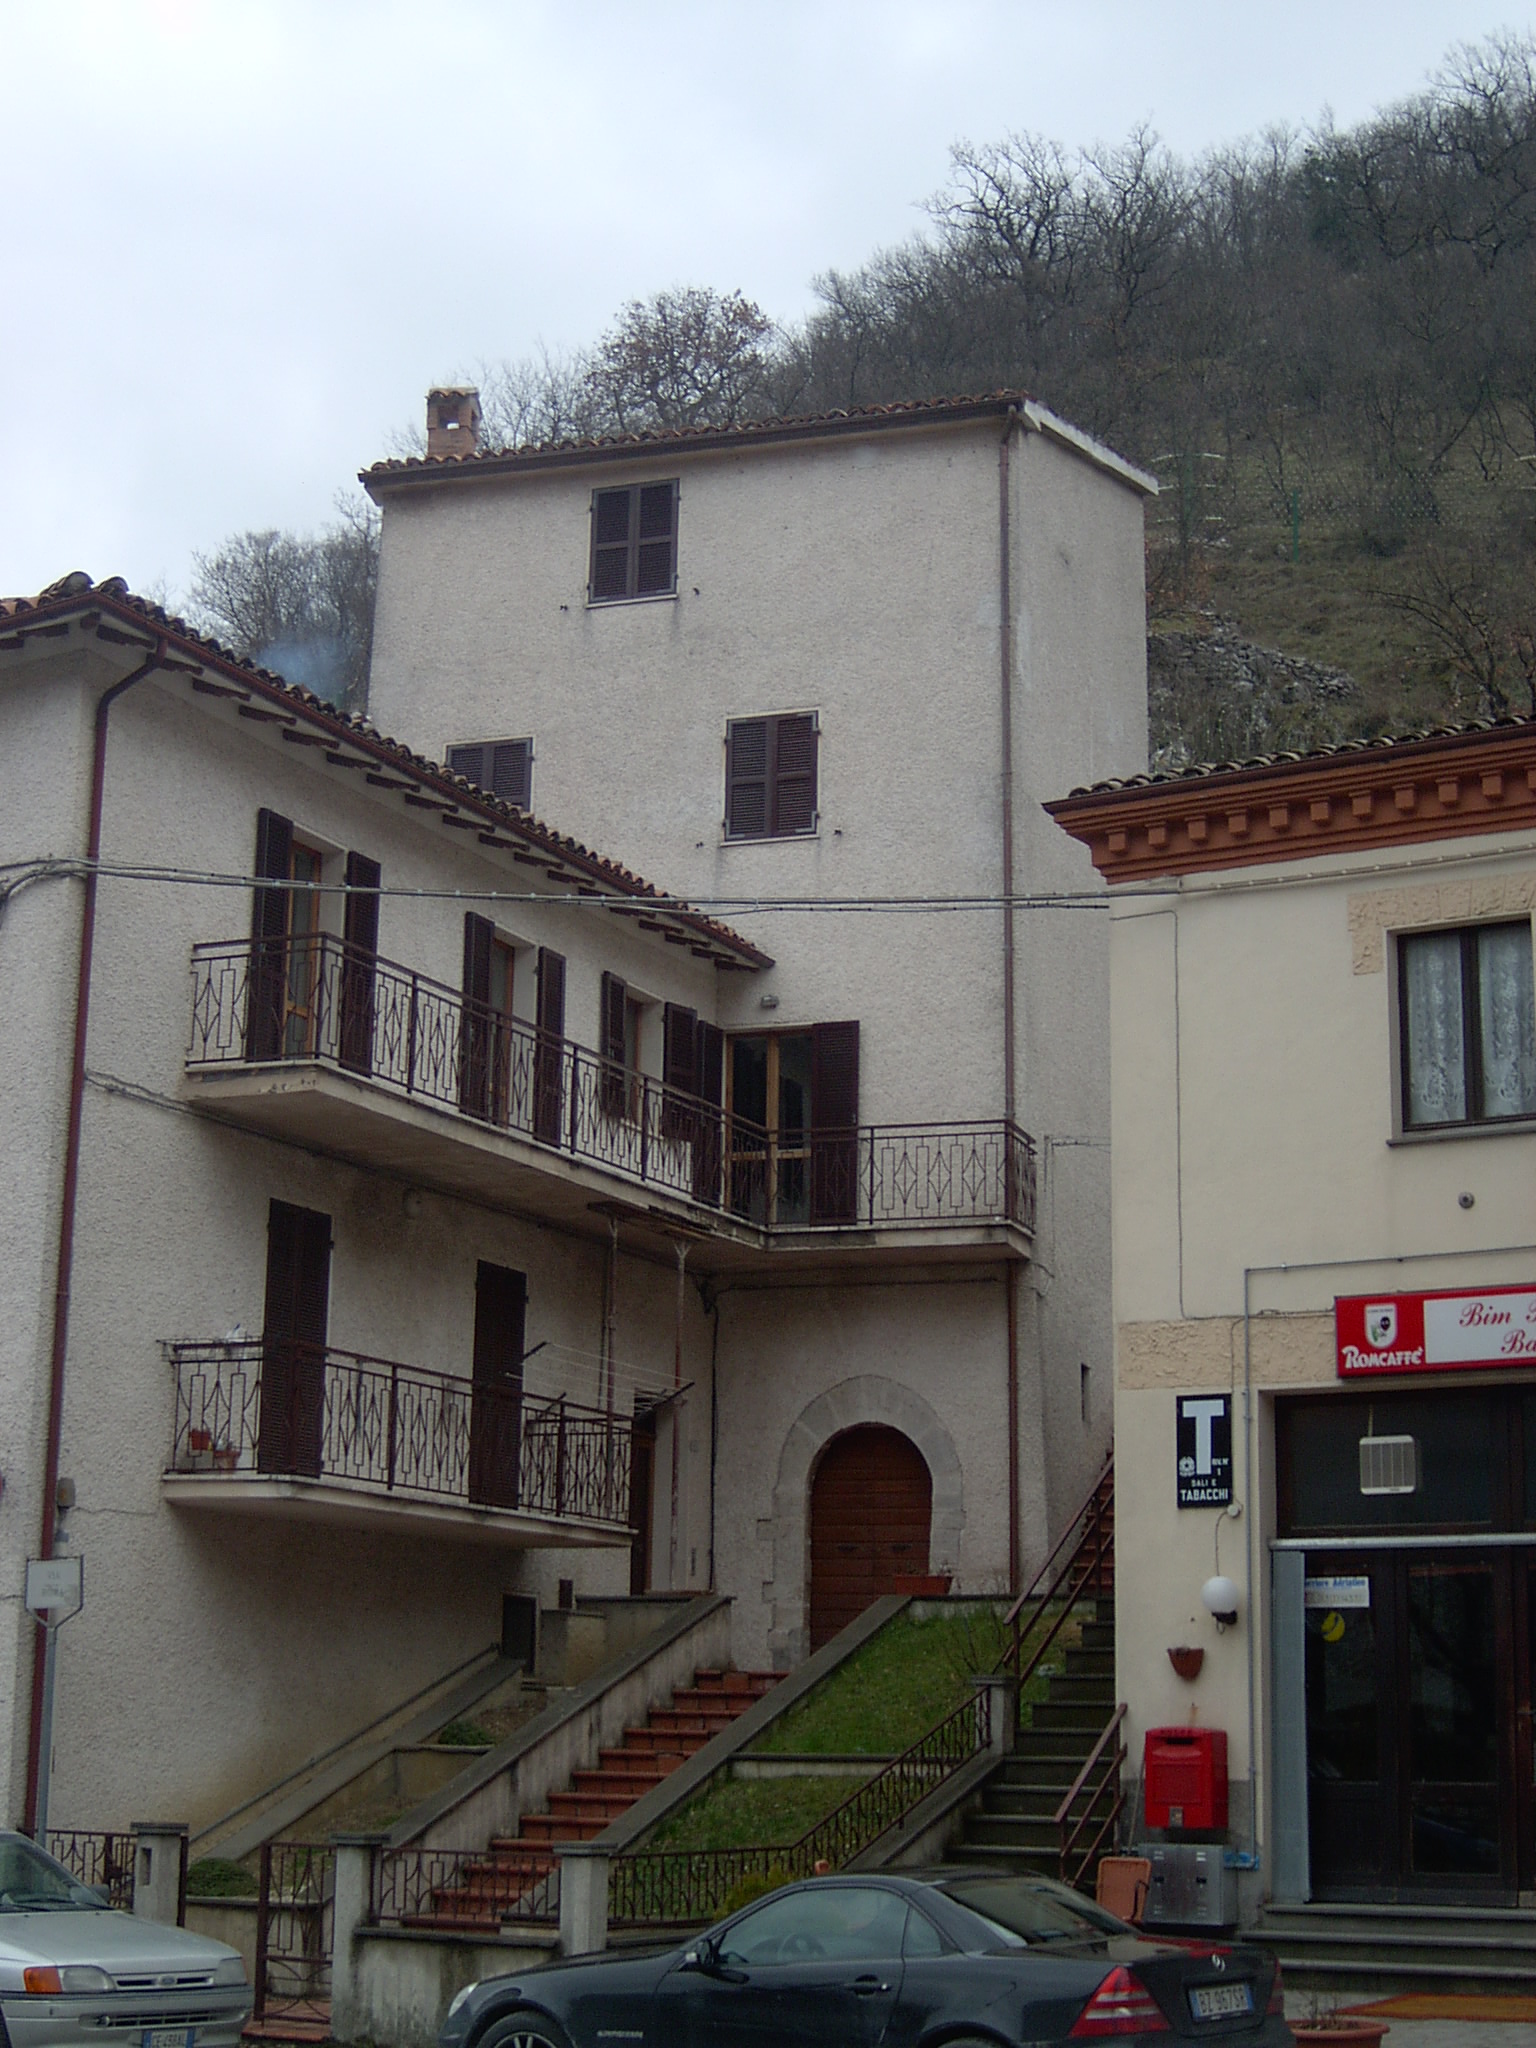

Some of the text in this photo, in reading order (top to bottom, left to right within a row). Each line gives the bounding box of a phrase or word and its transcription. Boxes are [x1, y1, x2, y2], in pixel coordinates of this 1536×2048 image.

[1459, 1302, 1511, 1327] Bim
[1183, 1399, 1225, 1475] T
[1191, 1478, 1217, 1488] SALI E
[1180, 1488, 1228, 1501] TABACCHI
